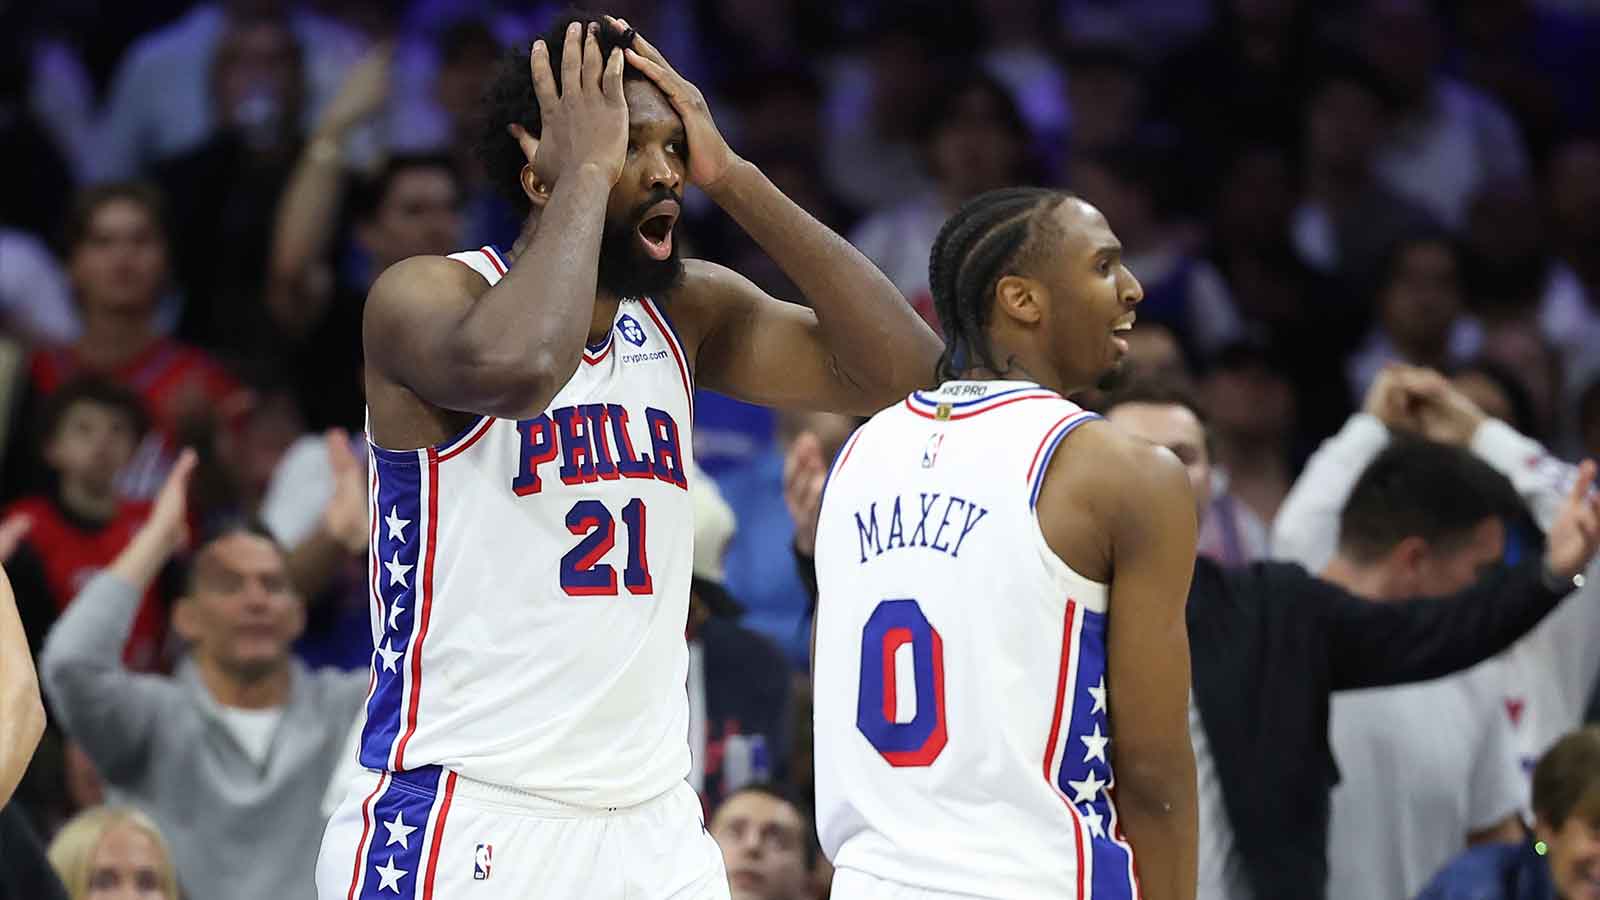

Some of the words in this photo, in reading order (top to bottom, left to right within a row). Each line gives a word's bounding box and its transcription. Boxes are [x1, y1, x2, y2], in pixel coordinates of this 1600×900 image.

[623, 350, 668, 363] crypto.com
[962, 384, 988, 396] PRO
[512, 403, 688, 496] PHILA
[560, 498, 653, 596] 21
[854, 493, 988, 563] MAXEY
[856, 599, 948, 767] 0
